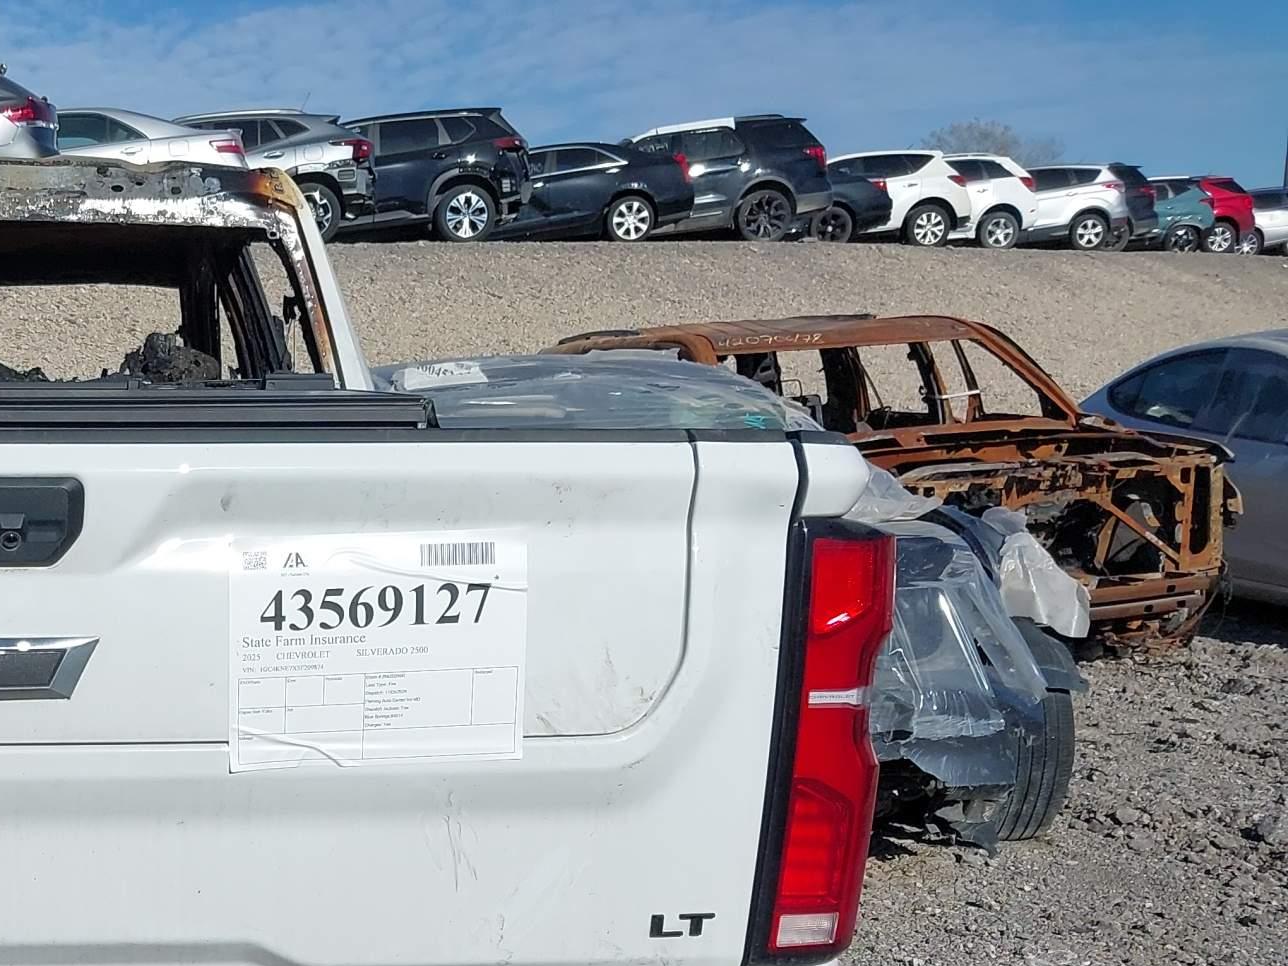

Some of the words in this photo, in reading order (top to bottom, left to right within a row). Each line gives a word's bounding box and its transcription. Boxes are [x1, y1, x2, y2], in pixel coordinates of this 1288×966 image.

[260, 583, 492, 631] 43569127
[242, 636, 271, 648] State
[276, 635, 306, 647] Farm
[310, 634, 366, 646] Insurance
[242, 653, 261, 662] 2025
[276, 650, 331, 661] CHEVROLET
[356, 647, 409, 657] SILVERADO
[410, 646, 429, 655] 2500
[649, 912, 717, 938] LT
